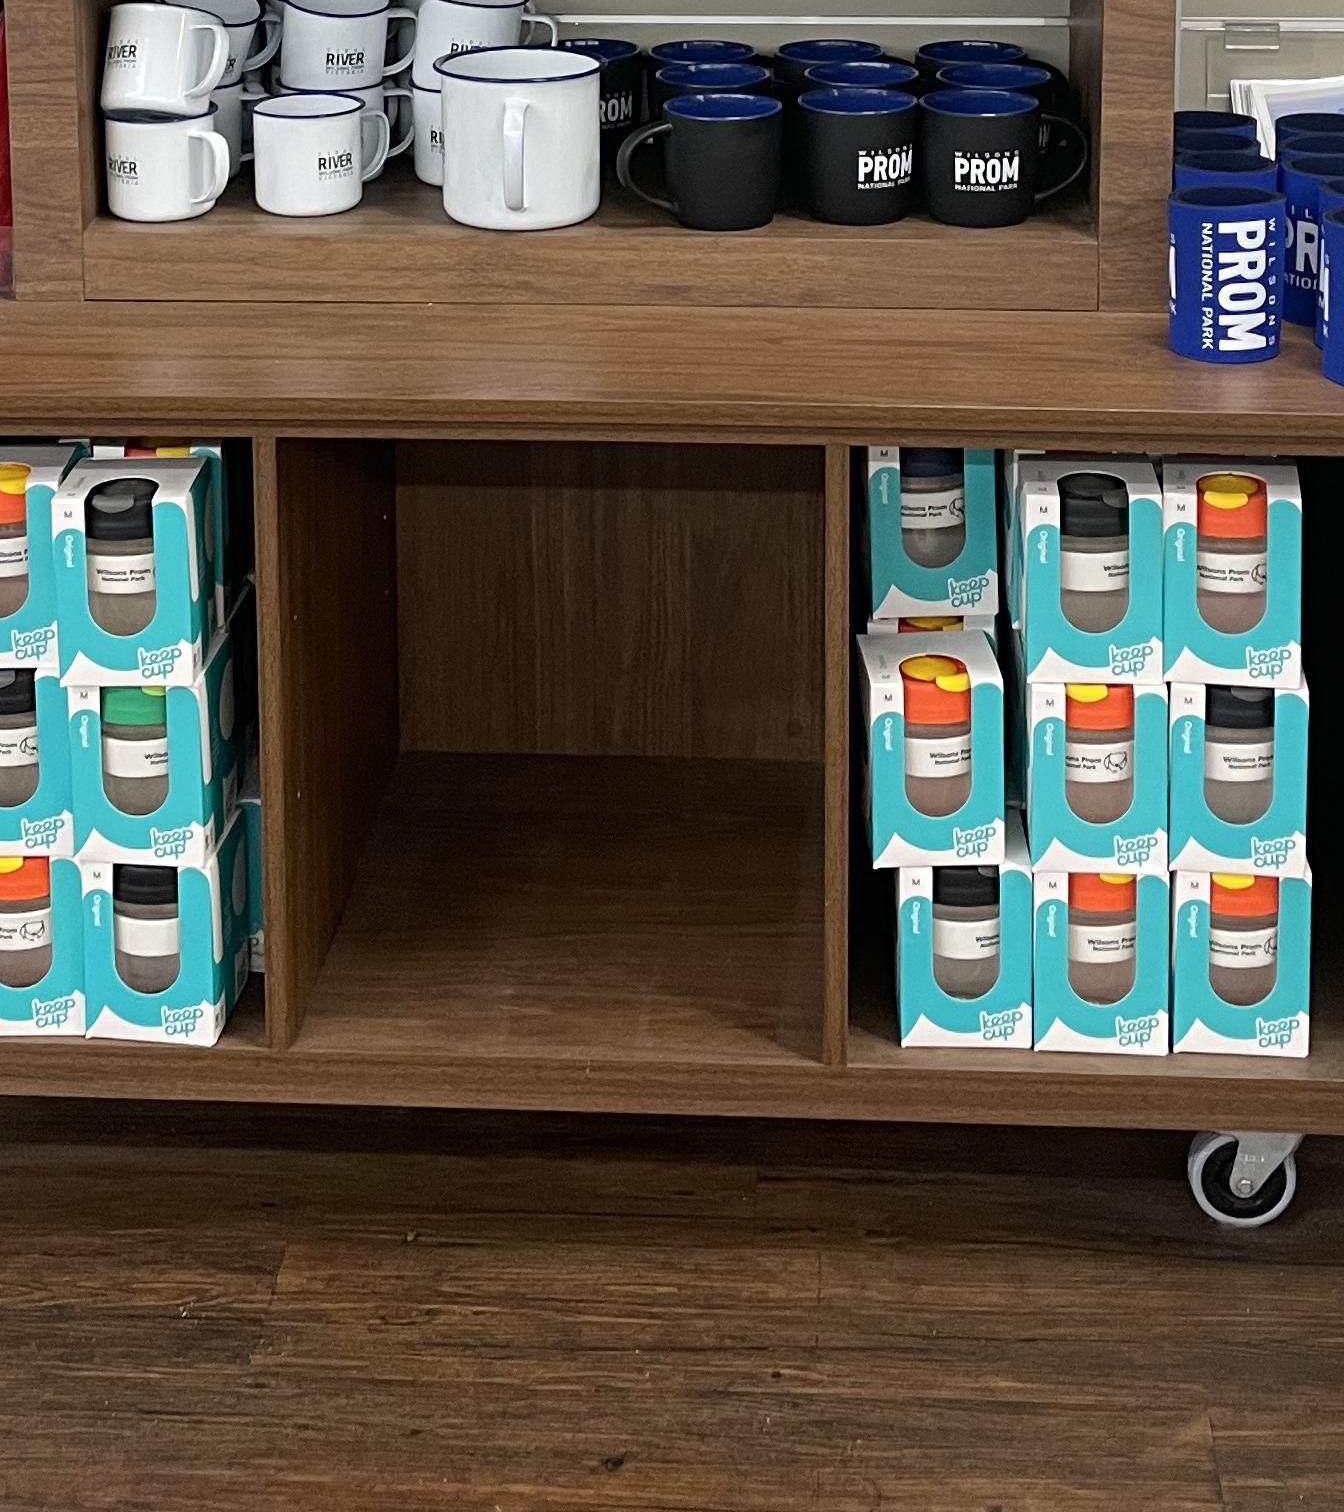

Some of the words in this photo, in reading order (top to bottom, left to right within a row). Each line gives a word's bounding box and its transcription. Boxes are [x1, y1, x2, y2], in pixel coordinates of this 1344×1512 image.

[108, 45, 137, 60] RIVER
[326, 52, 365, 66] RIVER
[599, 94, 633, 123] ROM
[318, 153, 353, 170] RIVER
[954, 149, 1020, 159] WILSONS
[109, 160, 137, 175] RIVER
[858, 150, 912, 182] PROM
[954, 156, 1019, 185] PROM
[954, 184, 996, 192] NATIONAL
[1201, 223, 1214, 302] NATIONAL
[1218, 219, 1268, 352] PROM
[1267, 217, 1276, 346] WILSONS
[1201, 307, 1214, 350] PARK
[1040, 506, 1048, 514] M
[948, 577, 989, 594] keep
[952, 591, 982, 607] cup
[12, 630, 55, 648] keep
[15, 644, 47, 660] cup
[139, 647, 182, 666] keep
[1110, 644, 1153, 662] keep
[1248, 648, 1291, 668] keep
[142, 663, 174, 678] cup
[1113, 659, 1144, 676] cup
[1250, 663, 1283, 679] cup
[23, 819, 65, 837] keep
[954, 826, 996, 845] keep
[25, 833, 56, 849] cup
[151, 829, 193, 847] keep
[1115, 836, 1158, 855] keep
[155, 844, 186, 859] cup
[957, 841, 988, 857] cup
[1252, 838, 1296, 856] keep
[1117, 850, 1150, 867] cup
[1254, 853, 1287, 868] cup
[34, 998, 75, 1017] keep
[36, 1013, 68, 1029] cup
[1258, 1019, 1300, 1036] keep
[1259, 1032, 1292, 1048] cup
